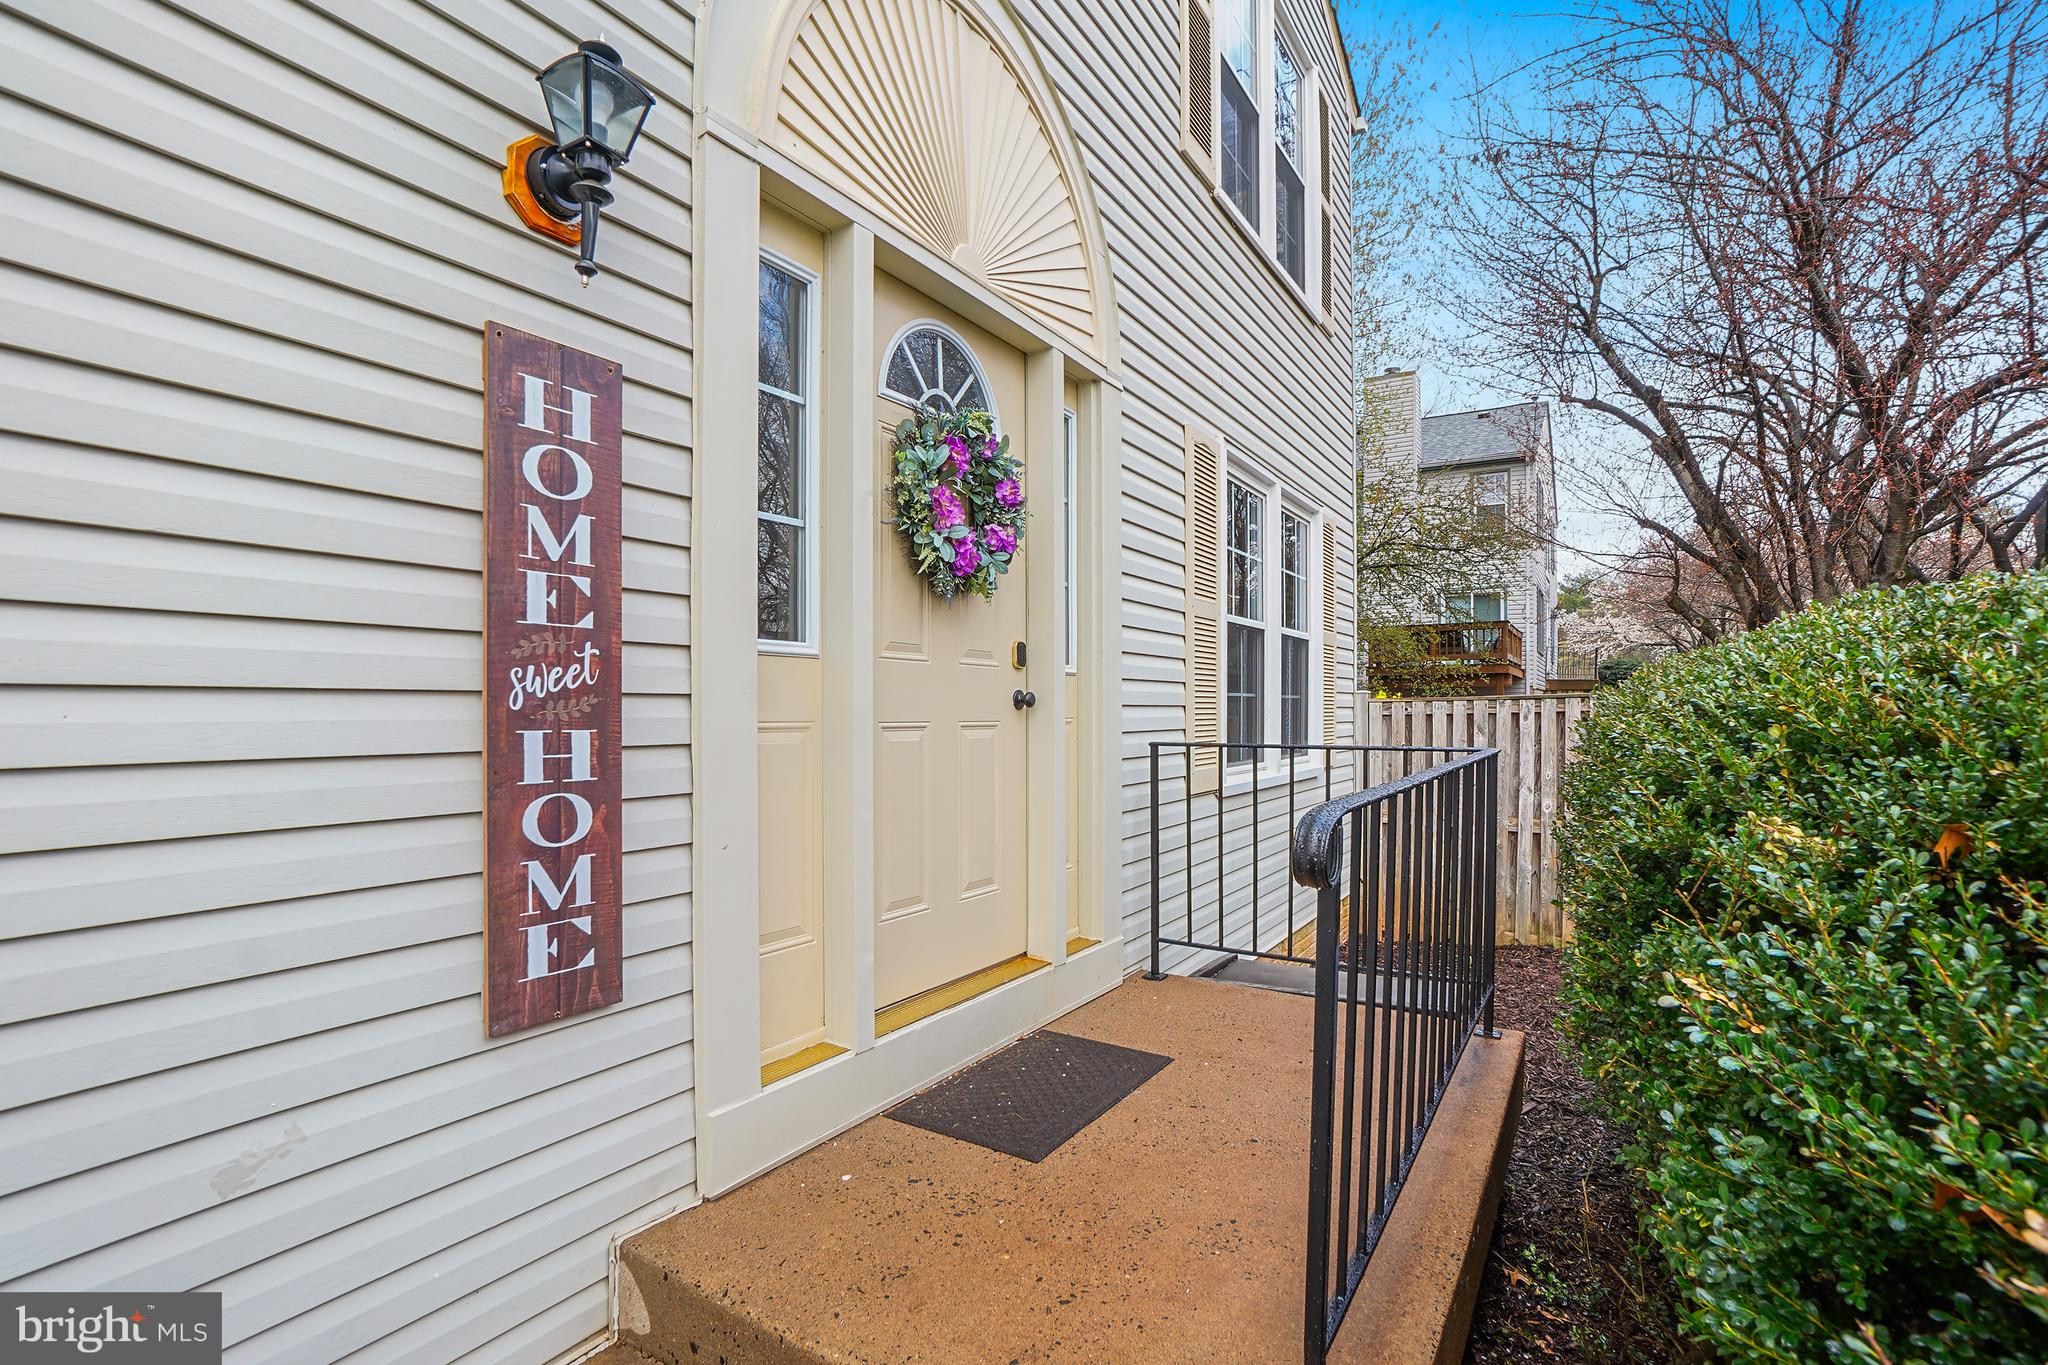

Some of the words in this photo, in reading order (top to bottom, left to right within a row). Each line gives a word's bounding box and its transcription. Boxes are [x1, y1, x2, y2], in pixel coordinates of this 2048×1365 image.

[517, 372, 598, 629] HOME
[509, 641, 600, 711] sweet
[515, 729, 598, 983] HOME
